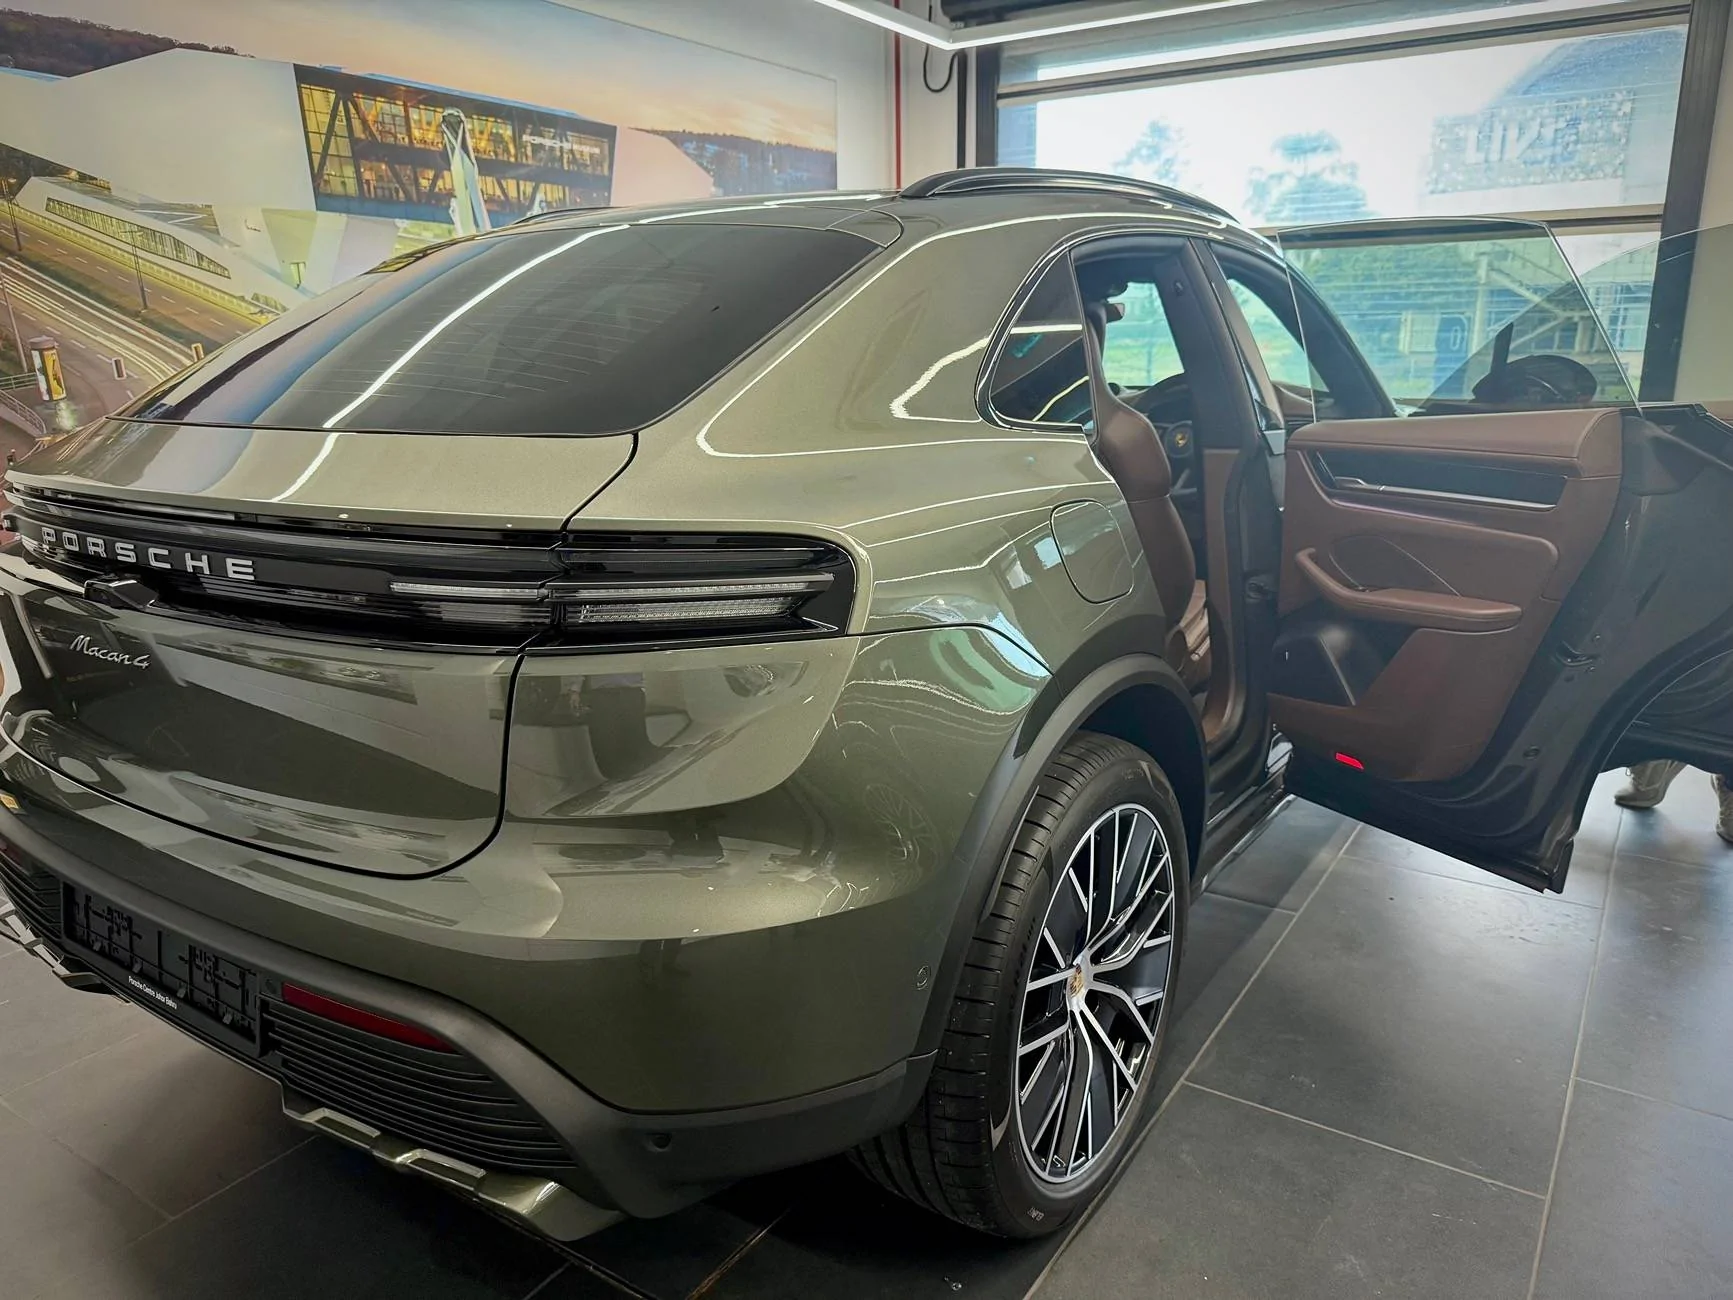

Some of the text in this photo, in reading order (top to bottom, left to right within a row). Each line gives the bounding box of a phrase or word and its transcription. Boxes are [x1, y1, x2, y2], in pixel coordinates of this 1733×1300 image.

[41, 527, 255, 581] PORSCHE
[69, 634, 151, 670] Macan 4
